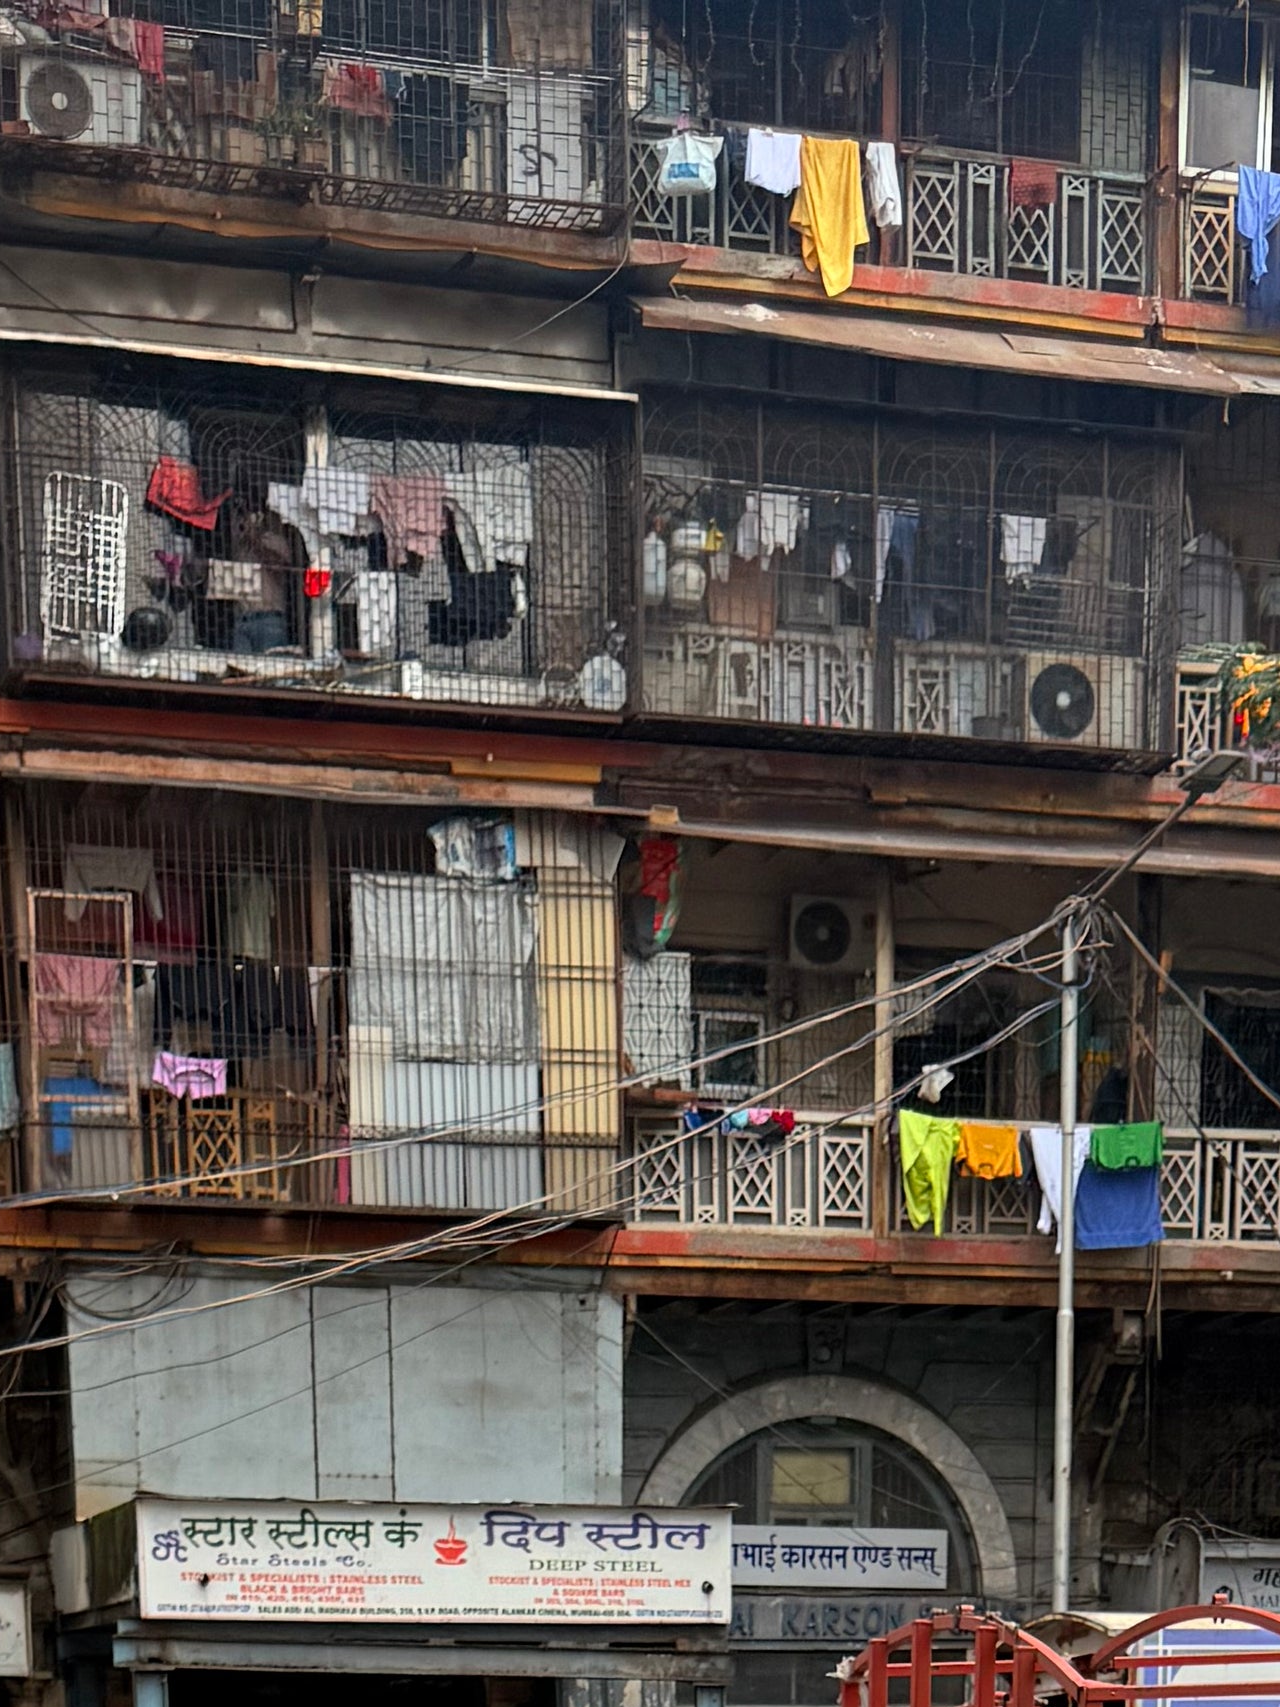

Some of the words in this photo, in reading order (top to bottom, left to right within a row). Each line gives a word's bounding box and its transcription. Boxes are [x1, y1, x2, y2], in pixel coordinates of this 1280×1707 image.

[181, 1517, 258, 1549] स्टार
[265, 1508, 374, 1550] स्टील्स
[382, 1508, 423, 1549] कं
[480, 1510, 570, 1552] दिप
[582, 1512, 711, 1551] स्टील
[529, 1559, 587, 1573] DEEP
[594, 1560, 663, 1574] STEEL
[781, 1545, 850, 1570] कारसन
[852, 1546, 894, 1573] एण्ड
[328, 1574, 388, 1585] STAINLESS
[391, 1575, 424, 1585] STEEL
